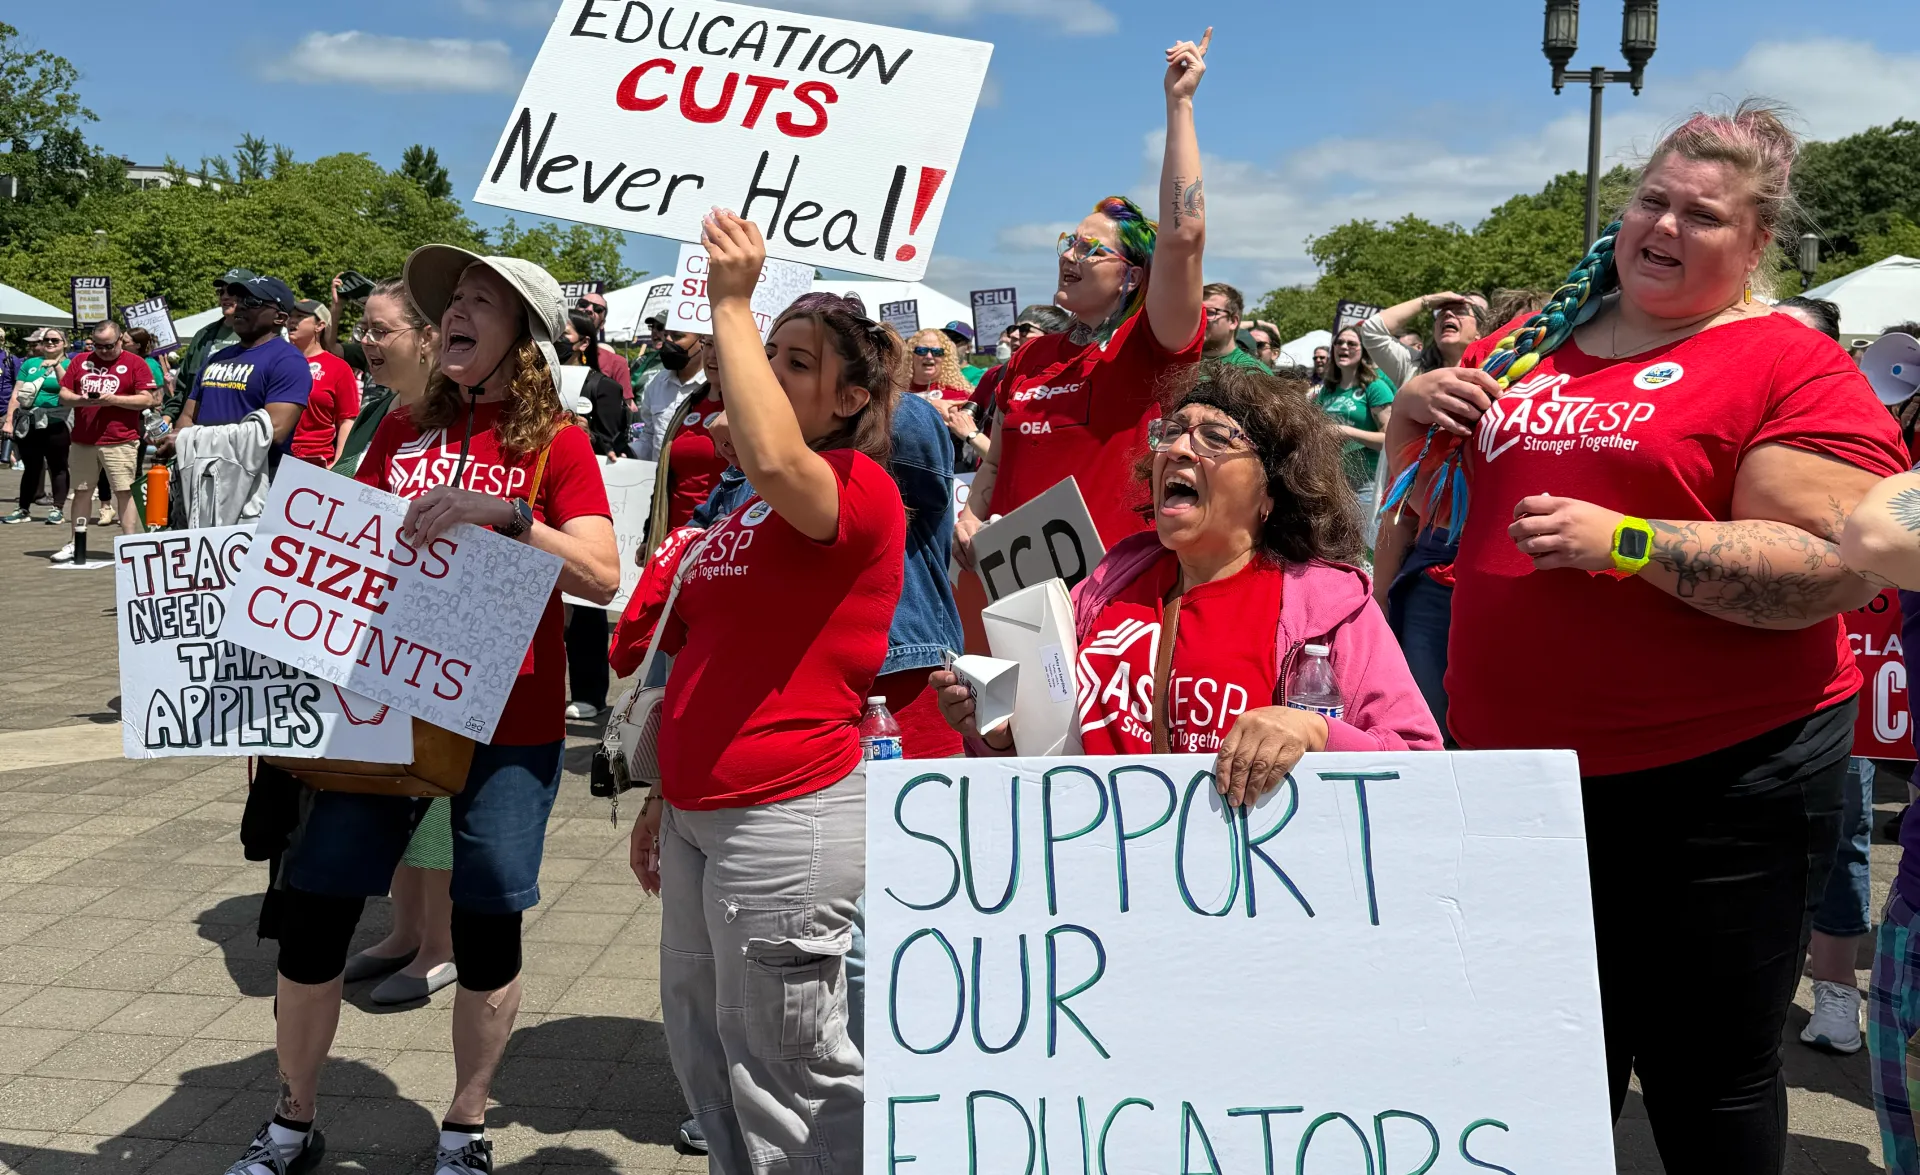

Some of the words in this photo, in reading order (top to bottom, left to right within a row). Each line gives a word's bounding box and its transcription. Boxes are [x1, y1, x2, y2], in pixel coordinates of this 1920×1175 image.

[570, 0, 914, 85] EDUCATION
[616, 57, 839, 138] CUTS
[491, 107, 704, 216] Never
[740, 150, 947, 262] Heal!
[75, 277, 106, 288] SEIU
[124, 297, 164, 319] SEIU
[649, 285, 673, 298] SEI
[974, 290, 1012, 305] SEIU
[882, 301, 915, 317] SEIU
[1019, 420, 1052, 435] OEA
[1503, 401, 1656, 436] ASKESP
[1523, 434, 1577, 456] Stronger
[1579, 433, 1640, 452] Together
[284, 487, 458, 580] CLASS
[119, 531, 253, 597] TEAC
[264, 535, 399, 615] SIZE
[127, 593, 225, 645] NEED
[247, 585, 472, 701] COUNTS
[1848, 633, 1904, 657] CLA
[145, 682, 325, 750] APPLES
[1177, 728, 1226, 752] Togeth
[884, 763, 1401, 926] SUPPORT
[888, 923, 1111, 1060] OUR
